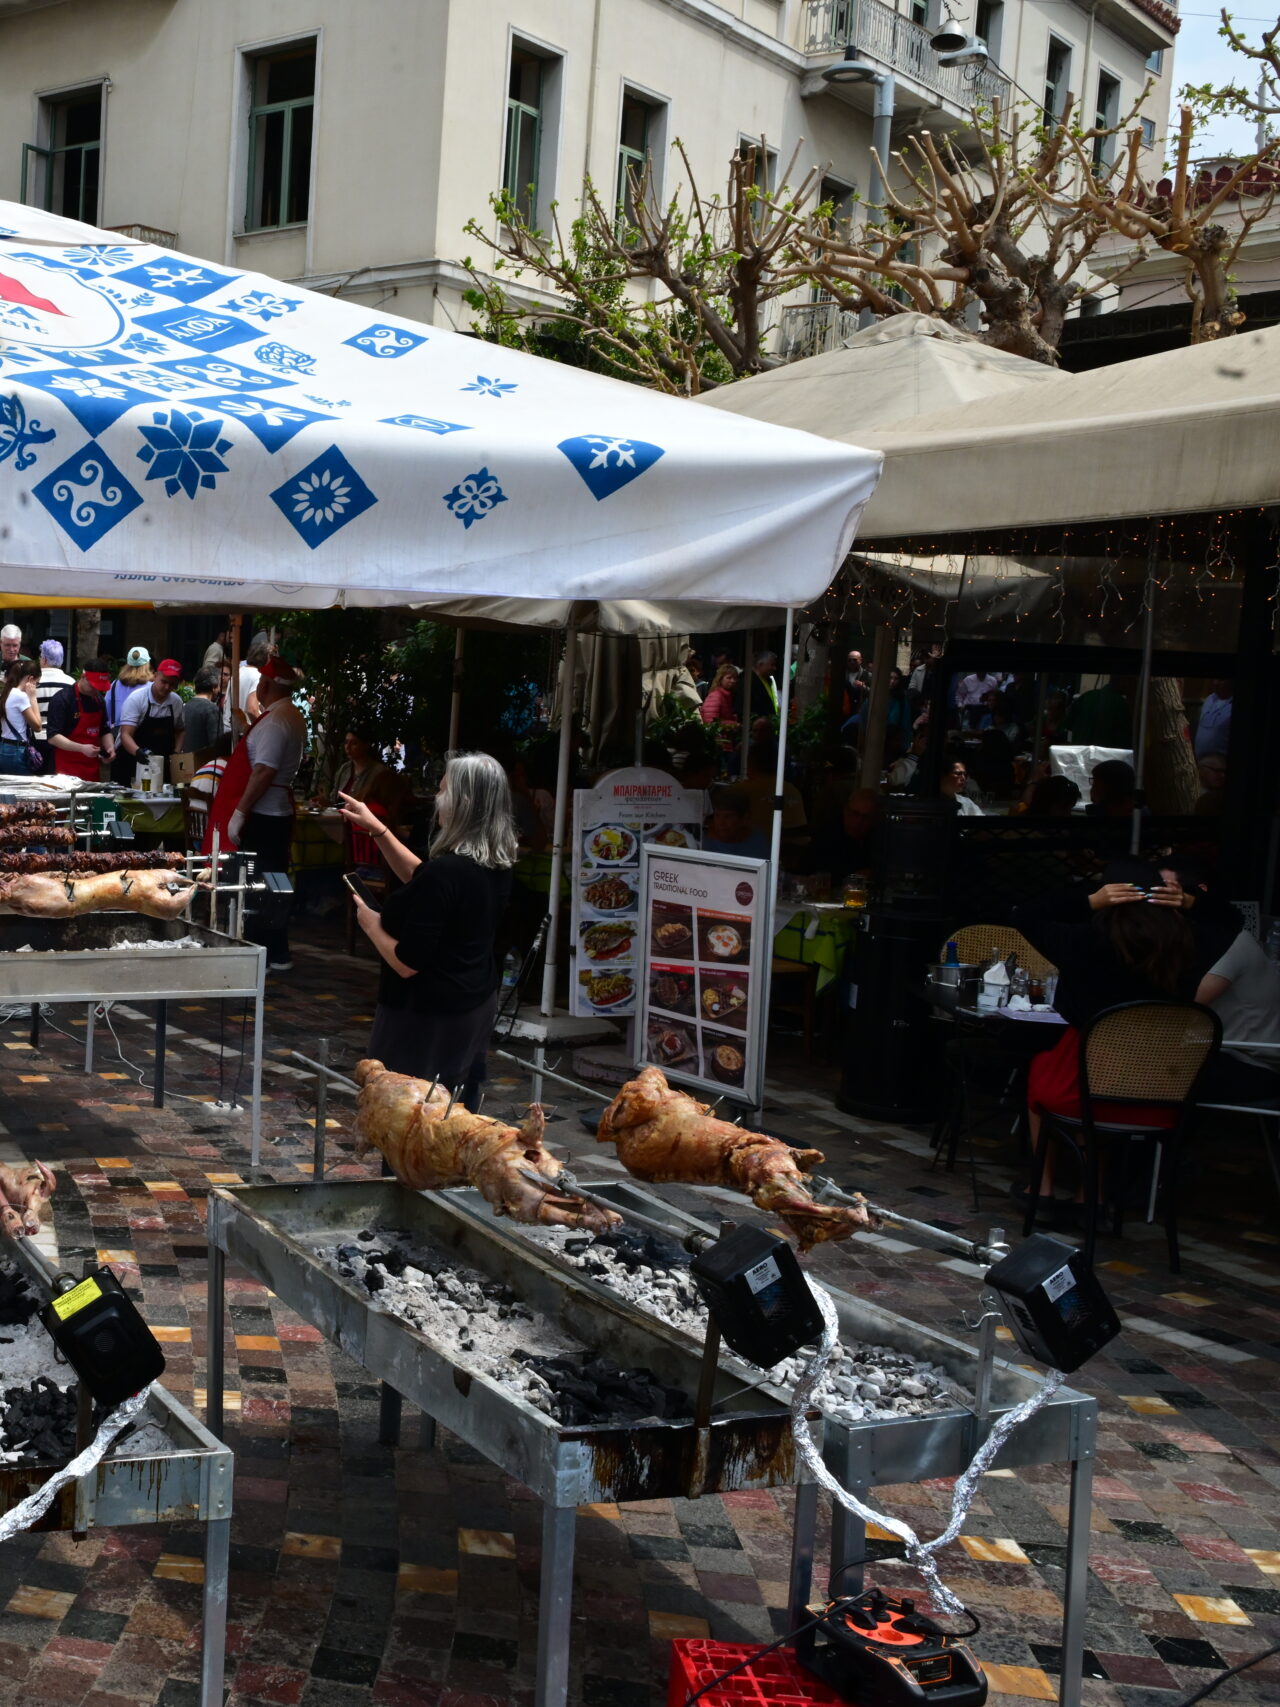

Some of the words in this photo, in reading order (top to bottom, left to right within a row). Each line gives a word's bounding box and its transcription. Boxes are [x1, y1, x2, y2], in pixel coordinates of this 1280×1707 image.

[653, 870, 680, 884] GREEK
[653, 882, 688, 895] TRADITIONAL
[689, 888, 708, 898] FOOD
[752, 1262, 768, 1275] AERO
[1049, 1272, 1064, 1285] AERO
